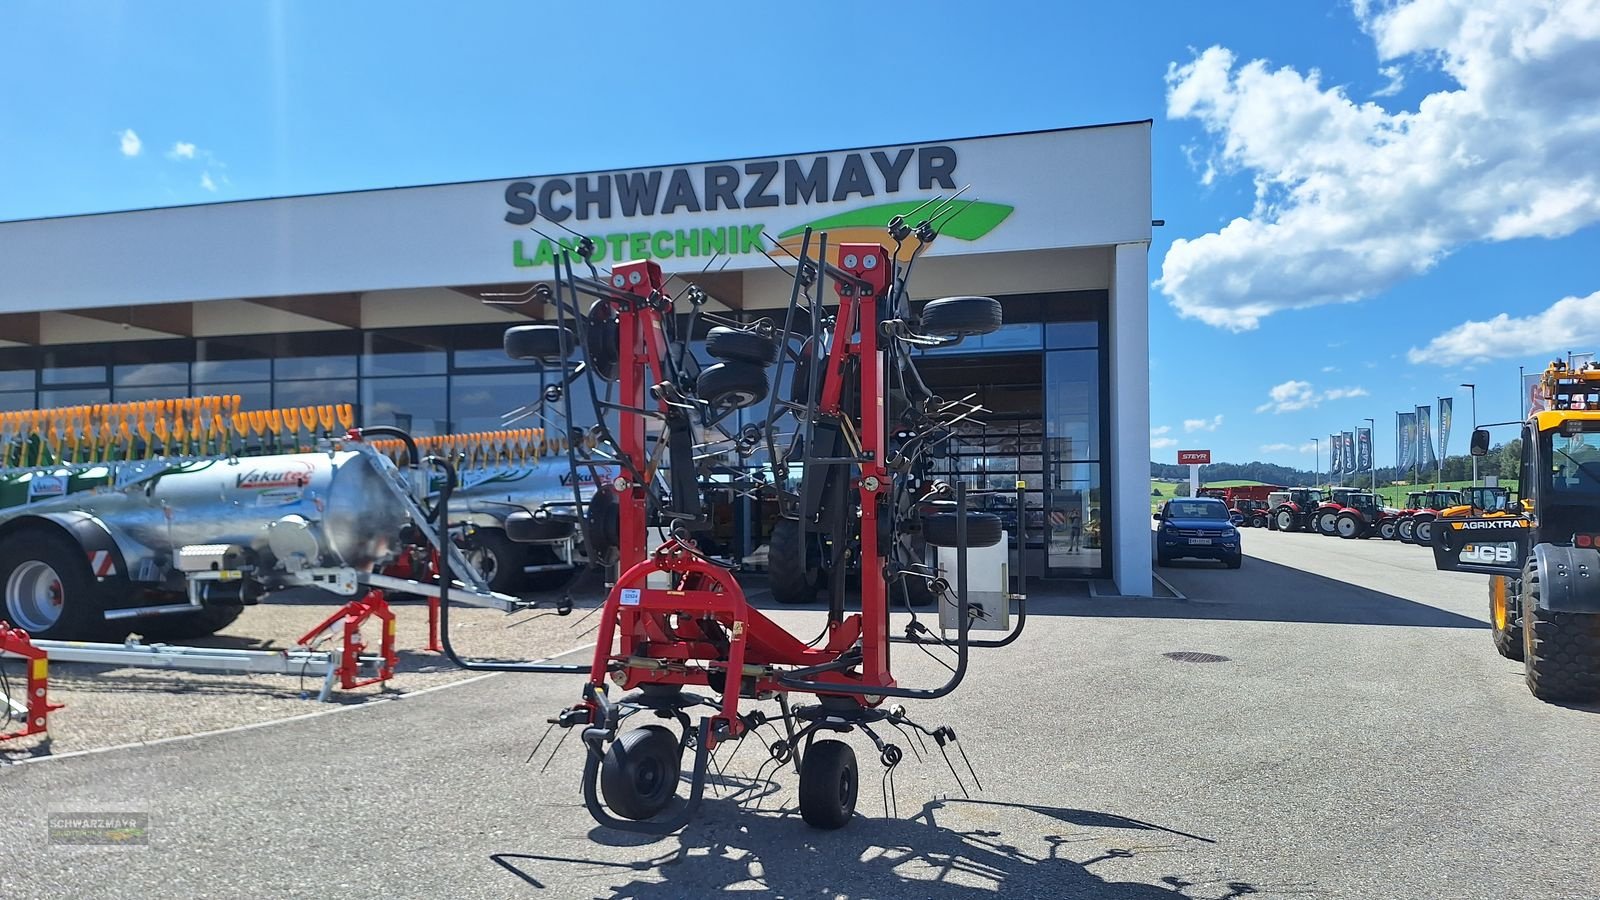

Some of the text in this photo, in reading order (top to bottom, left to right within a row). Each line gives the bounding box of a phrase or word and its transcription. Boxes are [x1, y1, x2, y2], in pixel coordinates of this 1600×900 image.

[504, 145, 958, 225] SCHWARZMAYR
[513, 223, 765, 268] LANDTECHNIK
[236, 469, 312, 488] Vakutec
[559, 472, 611, 486] Vkuec
[1462, 520, 1520, 530] AGRIXTRA
[1466, 545, 1512, 562] JCB
